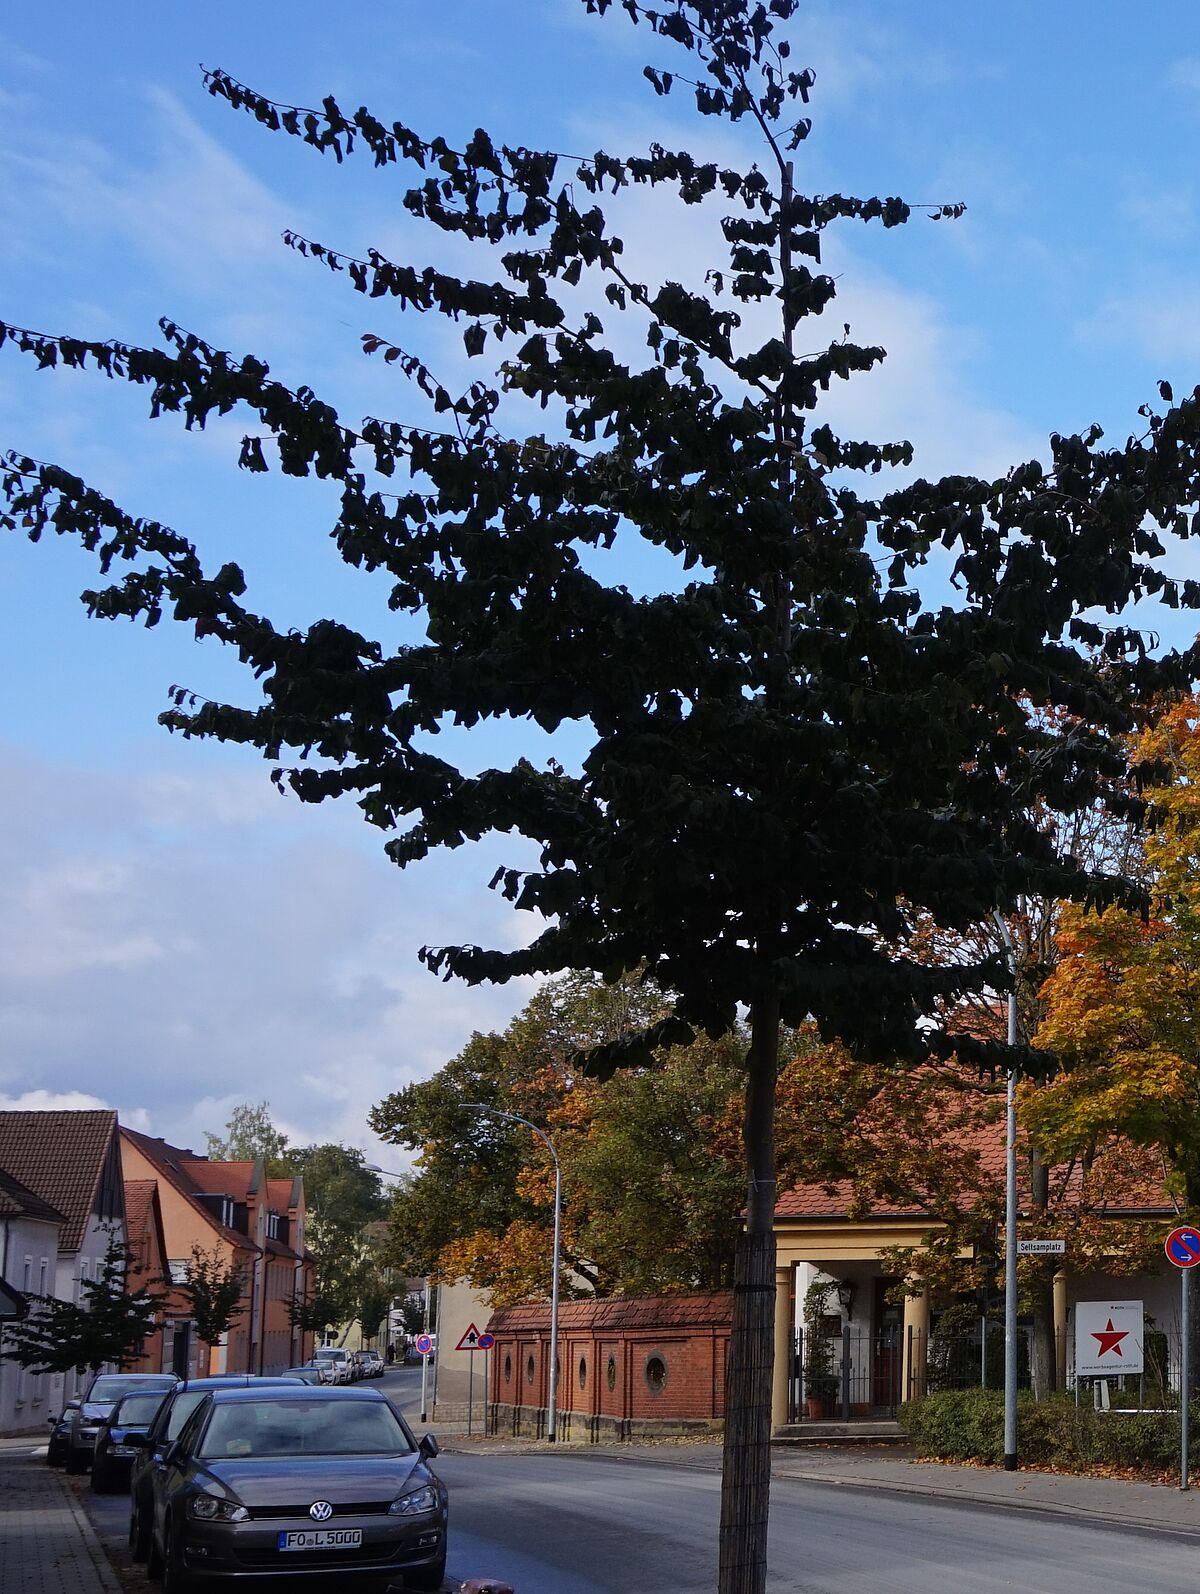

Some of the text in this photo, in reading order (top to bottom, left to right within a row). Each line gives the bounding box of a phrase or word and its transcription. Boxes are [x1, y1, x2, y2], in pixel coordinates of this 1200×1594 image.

[1020, 1243, 1061, 1252] Seltsamplatz
[287, 1531, 361, 1547] FO L 5000
